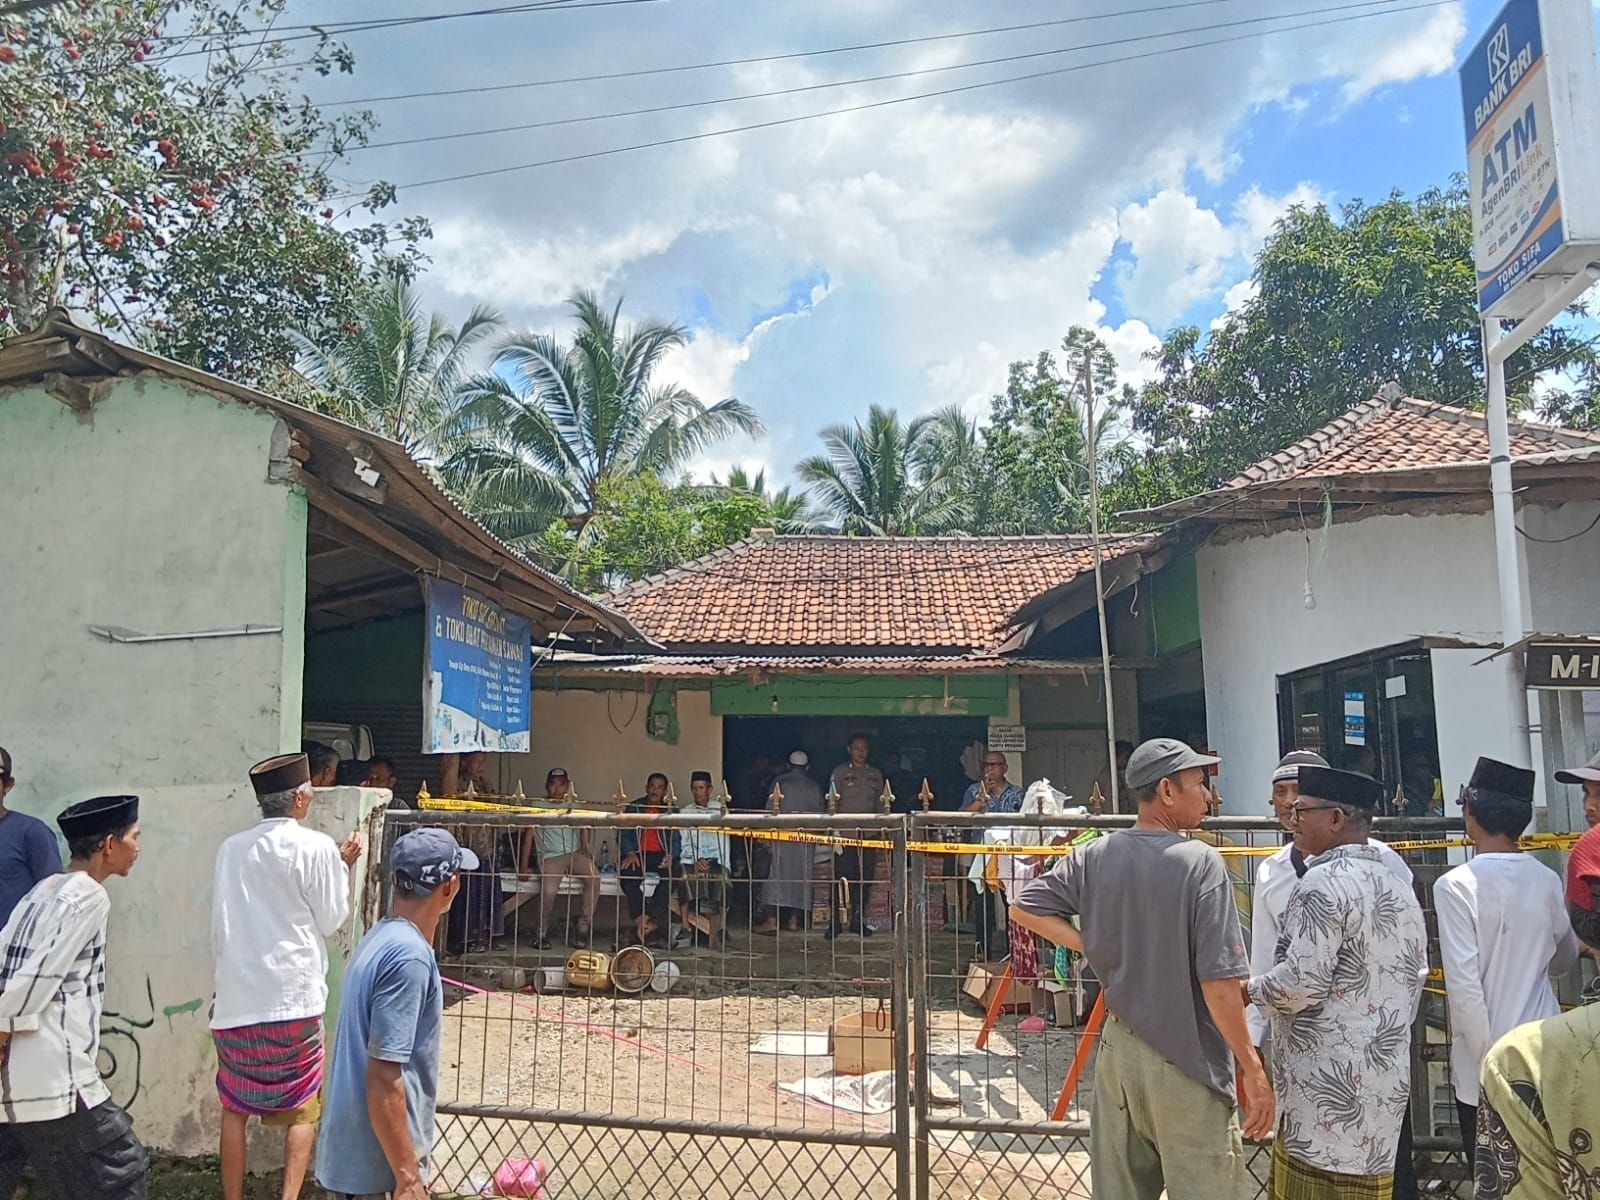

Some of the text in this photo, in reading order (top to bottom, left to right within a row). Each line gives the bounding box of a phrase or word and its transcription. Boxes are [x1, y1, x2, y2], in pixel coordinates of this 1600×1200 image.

[1474, 41, 1533, 131] BANK BRI
[1481, 101, 1538, 199] ATM
[1497, 260, 1520, 287] TOKO
[1521, 241, 1541, 266] SIFA
[435, 614, 443, 638] &
[446, 616, 465, 643] TOKO
